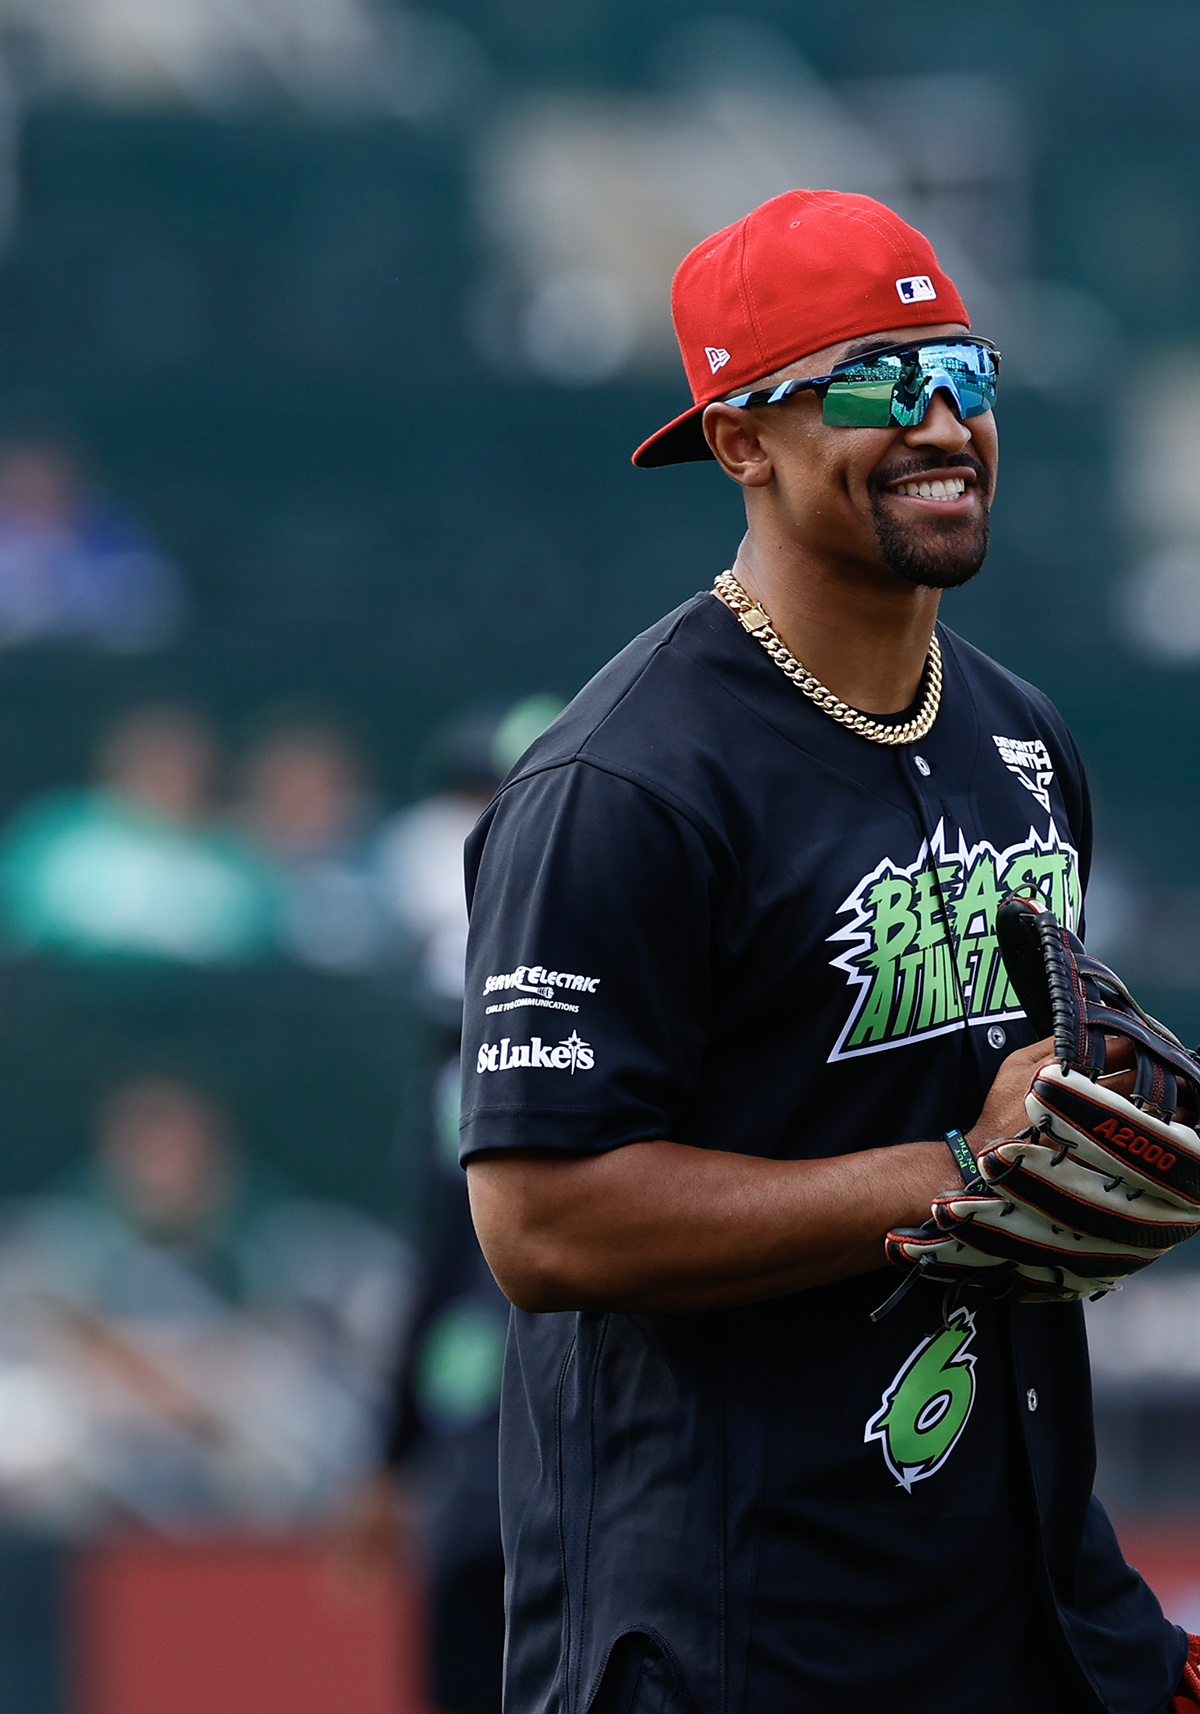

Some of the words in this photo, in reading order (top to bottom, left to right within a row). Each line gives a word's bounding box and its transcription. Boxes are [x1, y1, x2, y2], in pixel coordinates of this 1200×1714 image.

[992, 735, 1047, 754] DEVONTA
[998, 747, 1053, 770] SMITH
[527, 966, 601, 993] ELECTRIC
[514, 998, 580, 1013] COMMUNICATIONS
[957, 1136, 969, 1156] THE
[1093, 1118, 1177, 1172] A2000
[954, 1148, 968, 1168] PUT
[966, 1157, 977, 1174] ON
[868, 1309, 976, 1488] 6
